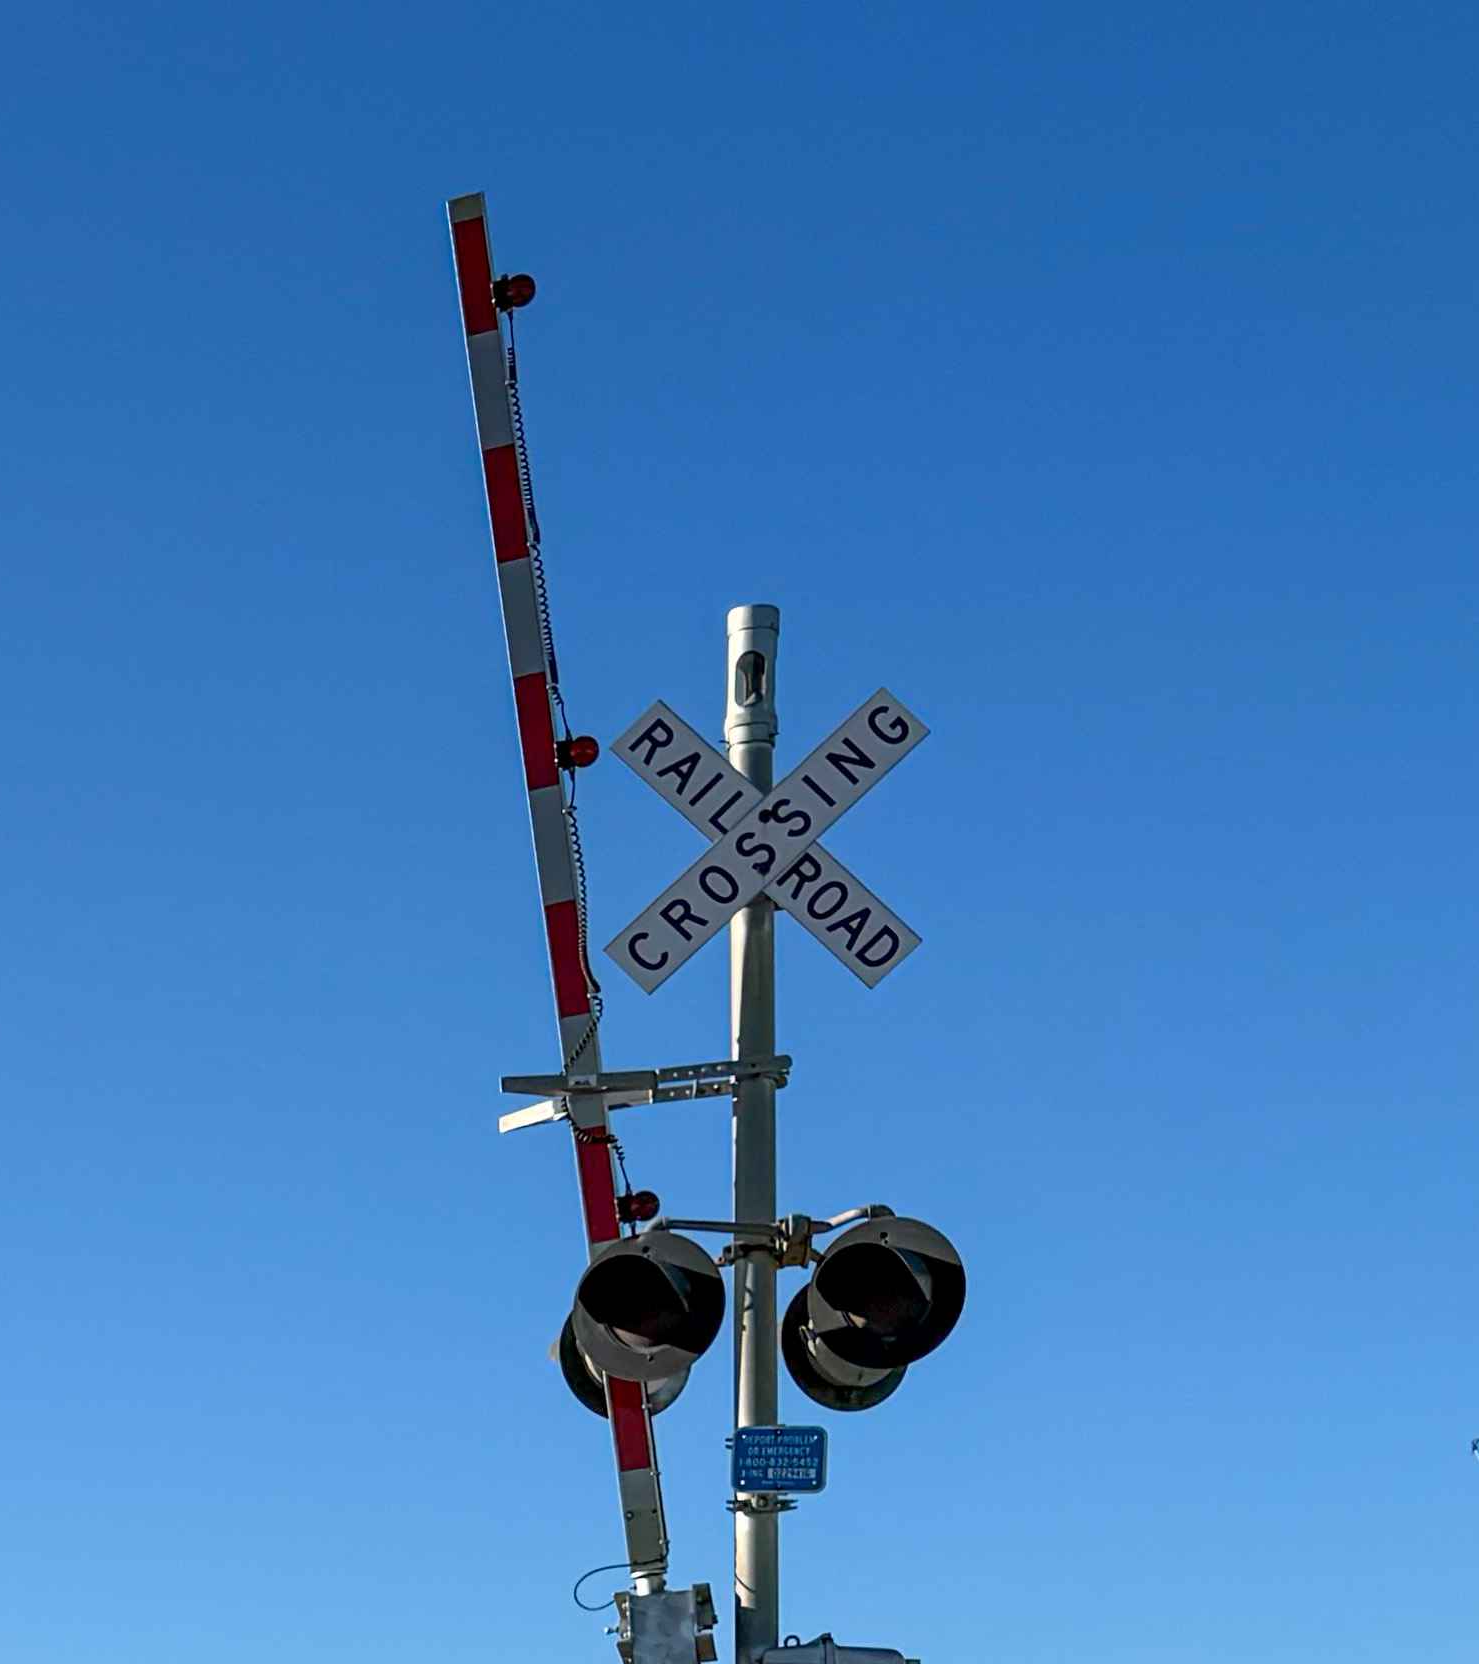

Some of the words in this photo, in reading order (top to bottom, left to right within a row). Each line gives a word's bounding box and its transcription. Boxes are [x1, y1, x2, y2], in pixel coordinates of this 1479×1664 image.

[627, 705, 910, 971] CROSSING
[628, 717, 744, 835] RAIL
[776, 852, 900, 969] ROAD
[761, 1447, 811, 1456] EMERGENCY
